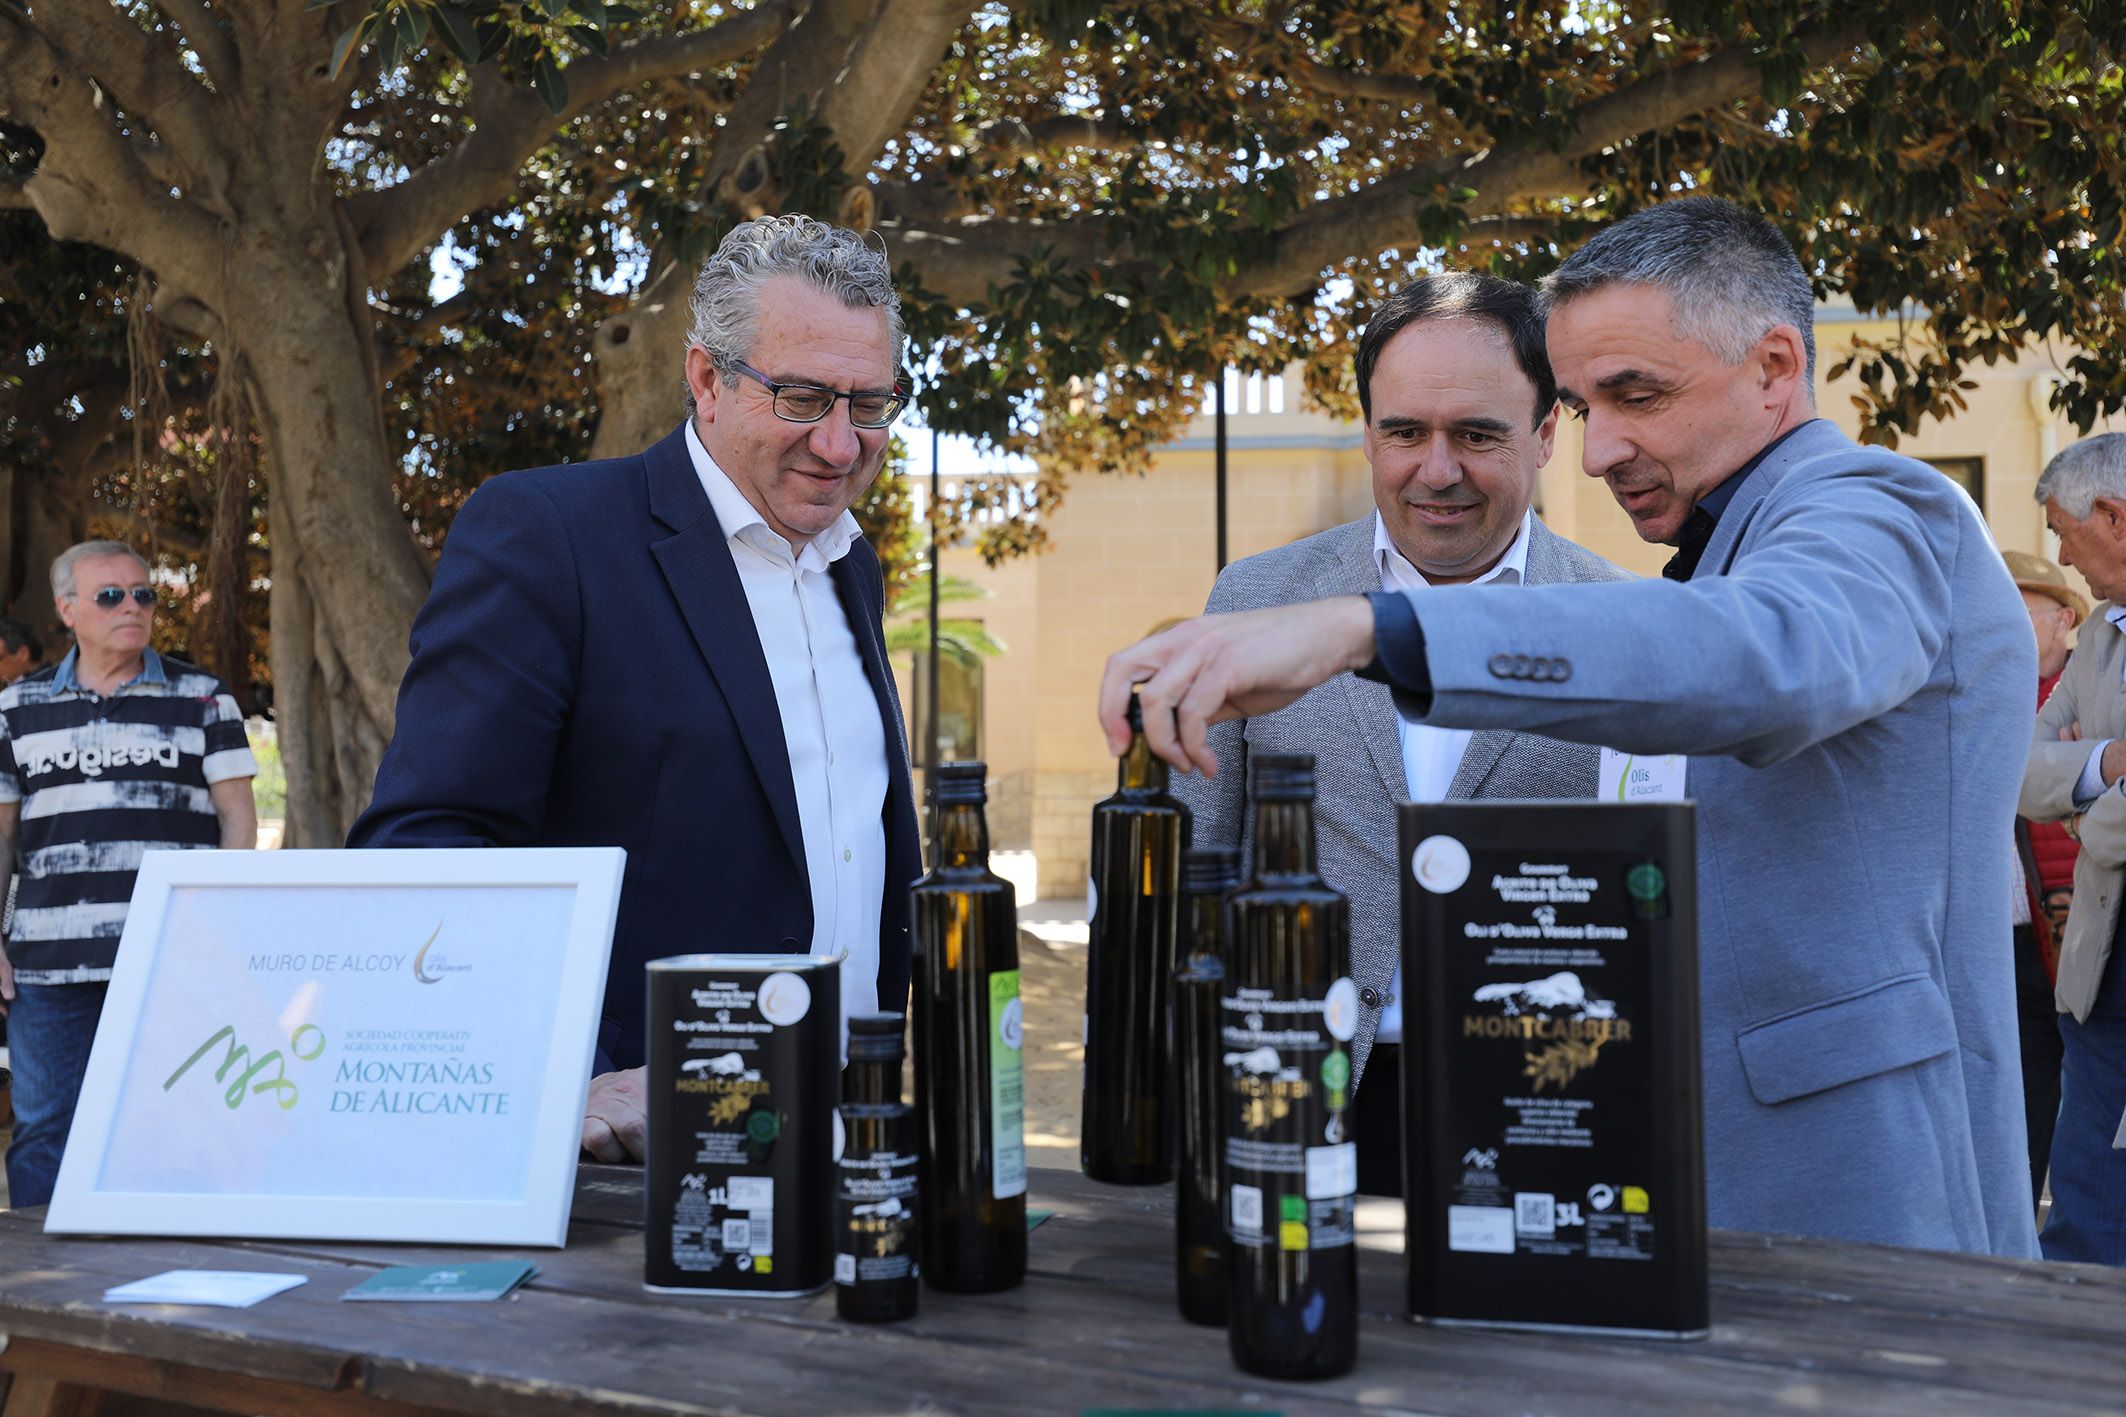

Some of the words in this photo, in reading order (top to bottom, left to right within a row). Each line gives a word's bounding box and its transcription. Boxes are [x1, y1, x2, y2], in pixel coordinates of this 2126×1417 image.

[1631, 769, 1650, 783] Olis
[248, 954, 306, 972] MURO
[311, 955, 337, 972] DE
[341, 954, 407, 972] ALCOY
[1463, 1016, 1632, 1041] MONTCABRER
[335, 1058, 495, 1084] MONTAÑAS
[330, 1090, 365, 1114] DE
[370, 1088, 510, 1116] ALICANTE
[1556, 1203, 1585, 1227] 3L
